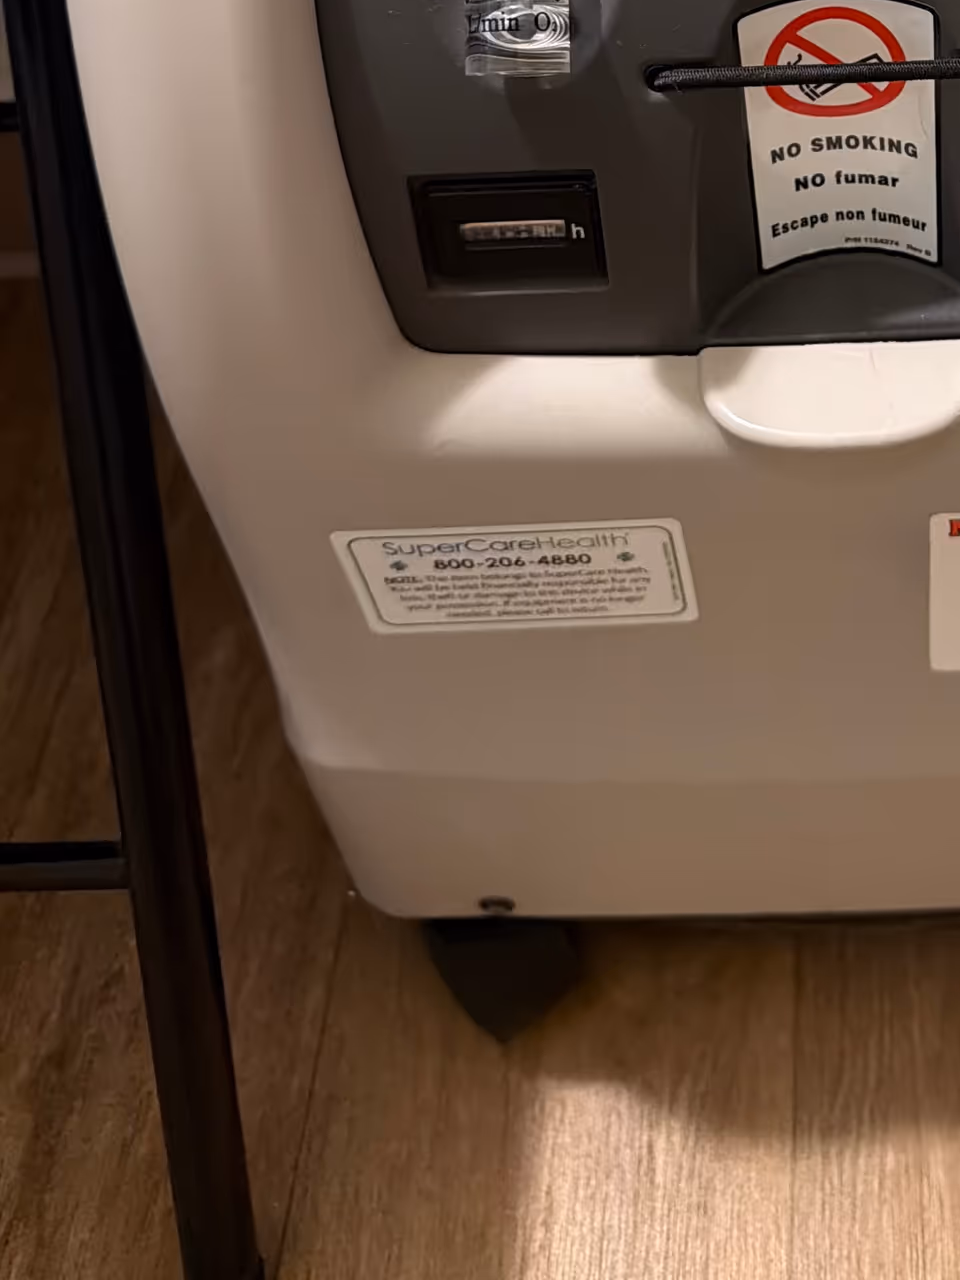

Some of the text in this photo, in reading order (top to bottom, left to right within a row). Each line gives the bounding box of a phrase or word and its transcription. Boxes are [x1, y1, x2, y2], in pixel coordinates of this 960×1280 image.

[468, 10, 520, 35] L/min
[770, 135, 919, 165] NO SMOKING
[794, 170, 900, 192] NO fumar
[571, 223, 586, 239] h
[771, 208, 928, 239] Escape non fumeur
[433, 552, 593, 571] 800-206-4880
